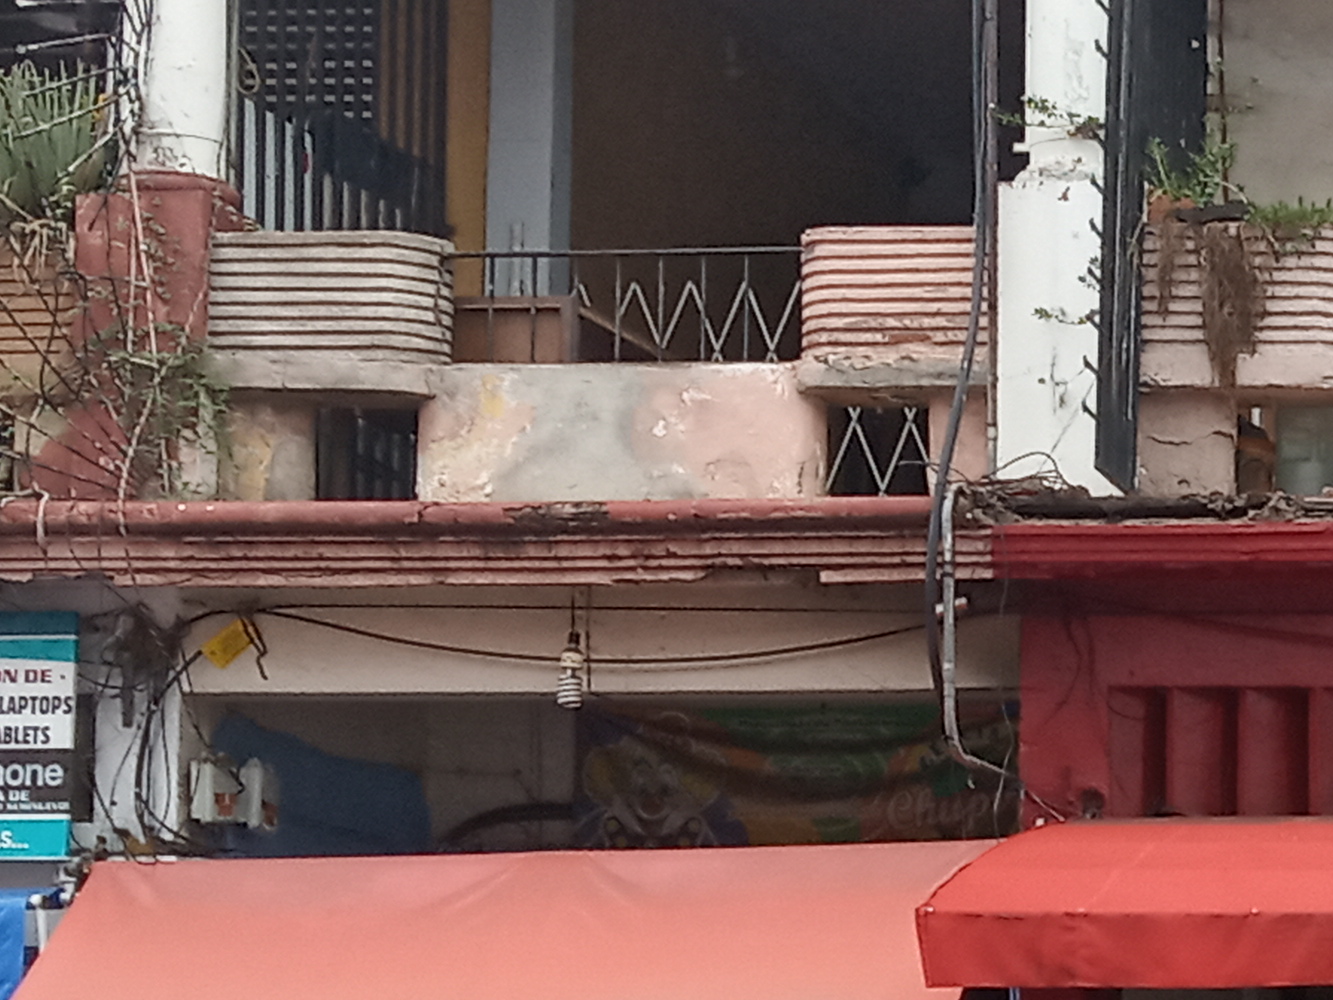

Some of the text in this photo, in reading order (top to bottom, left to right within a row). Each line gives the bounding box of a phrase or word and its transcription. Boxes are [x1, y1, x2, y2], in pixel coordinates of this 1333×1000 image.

[25, 669, 52, 683] DE
[0, 695, 73, 715] LAPTOPS
[0, 726, 51, 745] BLETS
